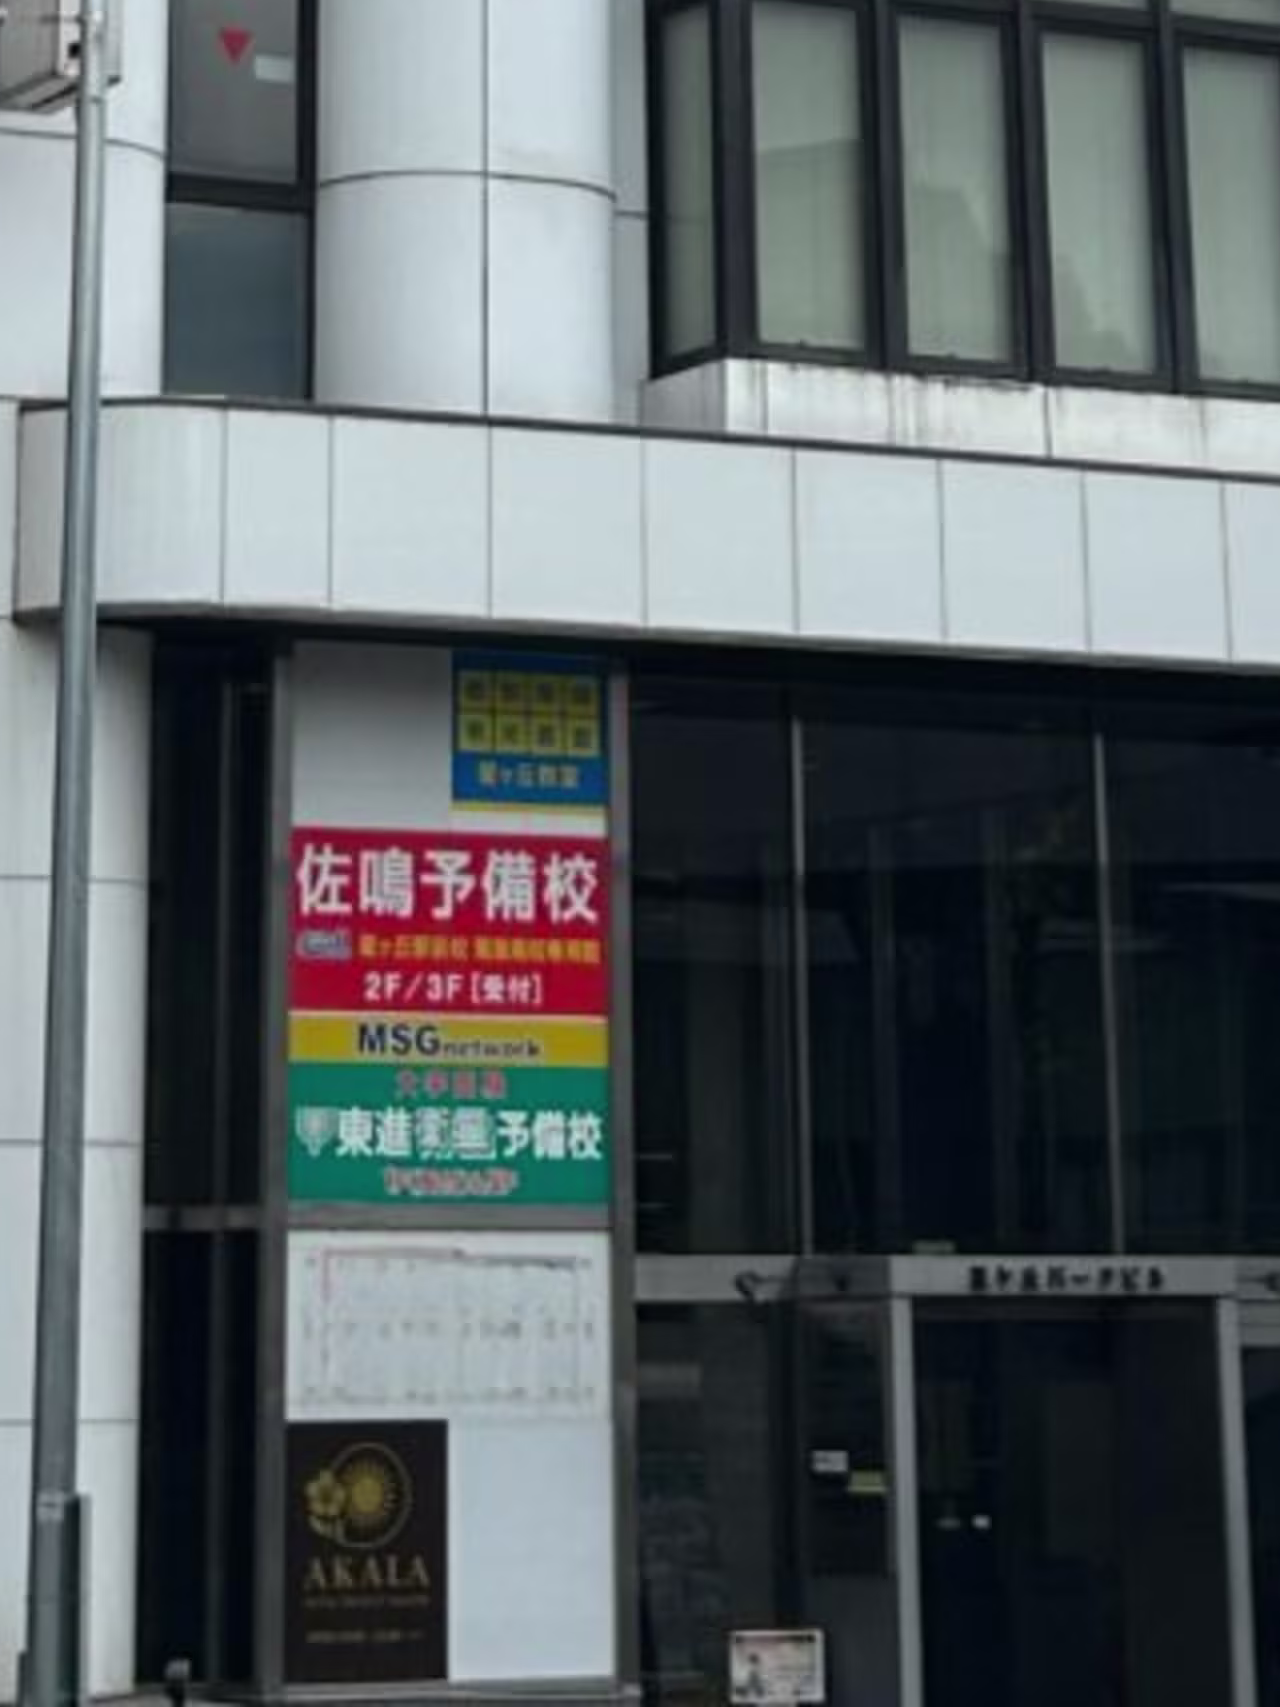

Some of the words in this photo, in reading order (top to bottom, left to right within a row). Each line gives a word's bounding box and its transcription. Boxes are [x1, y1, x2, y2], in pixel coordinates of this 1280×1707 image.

[295, 844, 600, 924] 佐鳴予備校
